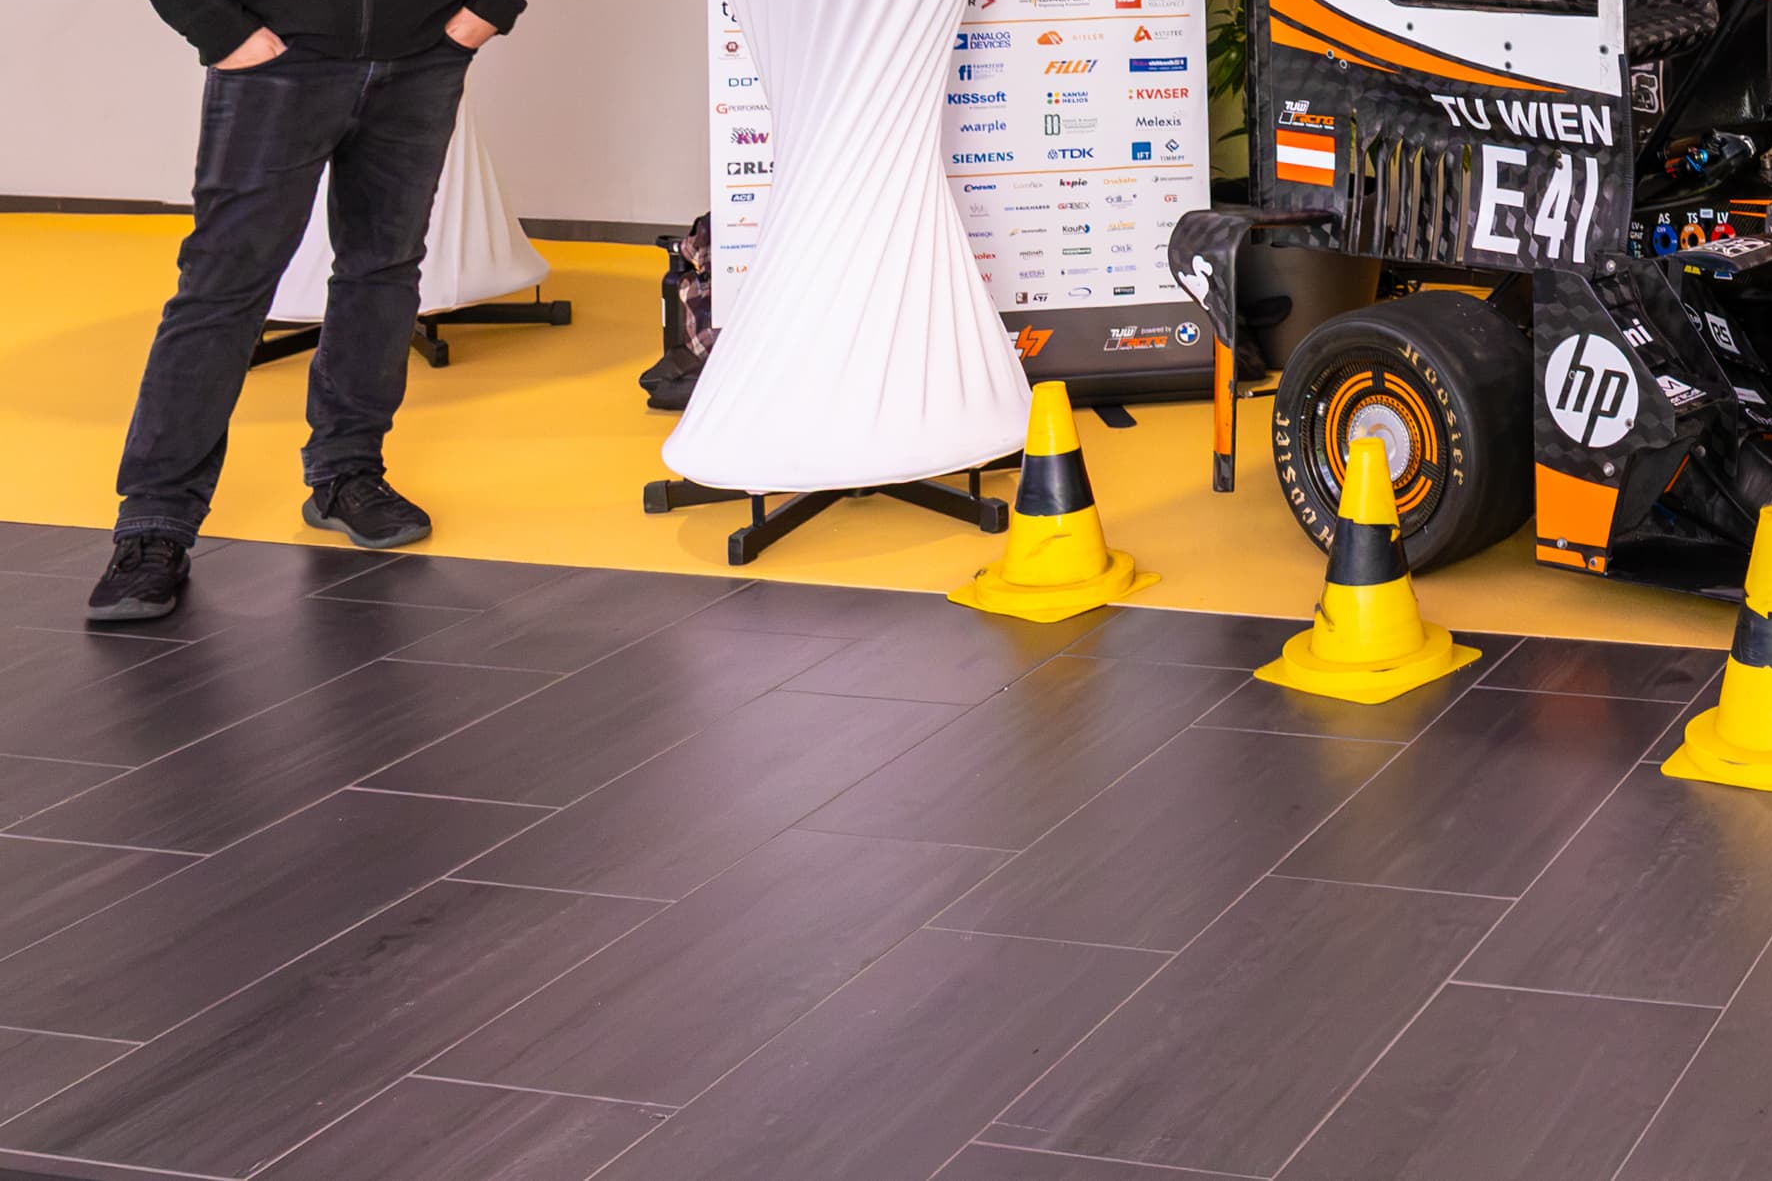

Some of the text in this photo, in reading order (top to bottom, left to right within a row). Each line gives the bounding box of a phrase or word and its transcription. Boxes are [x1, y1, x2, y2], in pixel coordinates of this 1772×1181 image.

[970, 31, 1011, 41] ANALOG
[970, 40, 1012, 50] DEVICES
[947, 91, 1007, 105] KISSsoft
[1136, 88, 1189, 100] KVASER
[960, 119, 1007, 134] marple
[1135, 117, 1182, 128] Melexis
[1430, 93, 1614, 147] TU WIEN
[952, 151, 1014, 164] SIEMENS
[1059, 147, 1095, 160] TDK
[1657, 212, 1671, 224] AS
[1686, 212, 1698, 224] TS
[1717, 211, 1729, 224] LV
[1622, 317, 1654, 348] ni
[1555, 333, 1630, 448] hp
